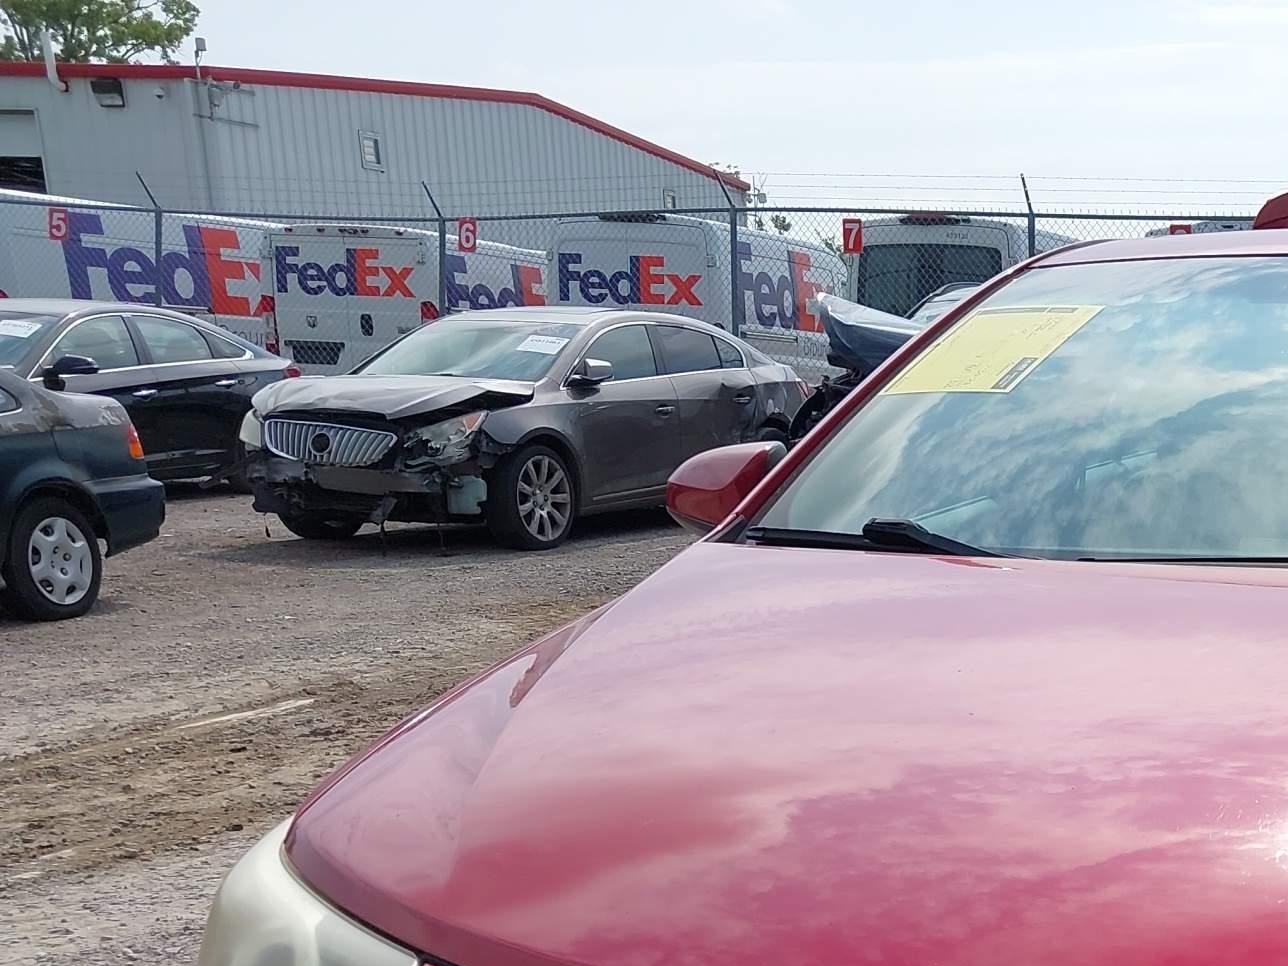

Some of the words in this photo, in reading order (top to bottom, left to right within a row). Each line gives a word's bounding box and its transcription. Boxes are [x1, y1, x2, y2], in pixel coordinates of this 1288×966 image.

[51, 211, 66, 237] 5
[460, 221, 475, 249] 6
[845, 223, 860, 249] 7
[275, 245, 416, 298] FedEx
[559, 252, 703, 306] FedEx
